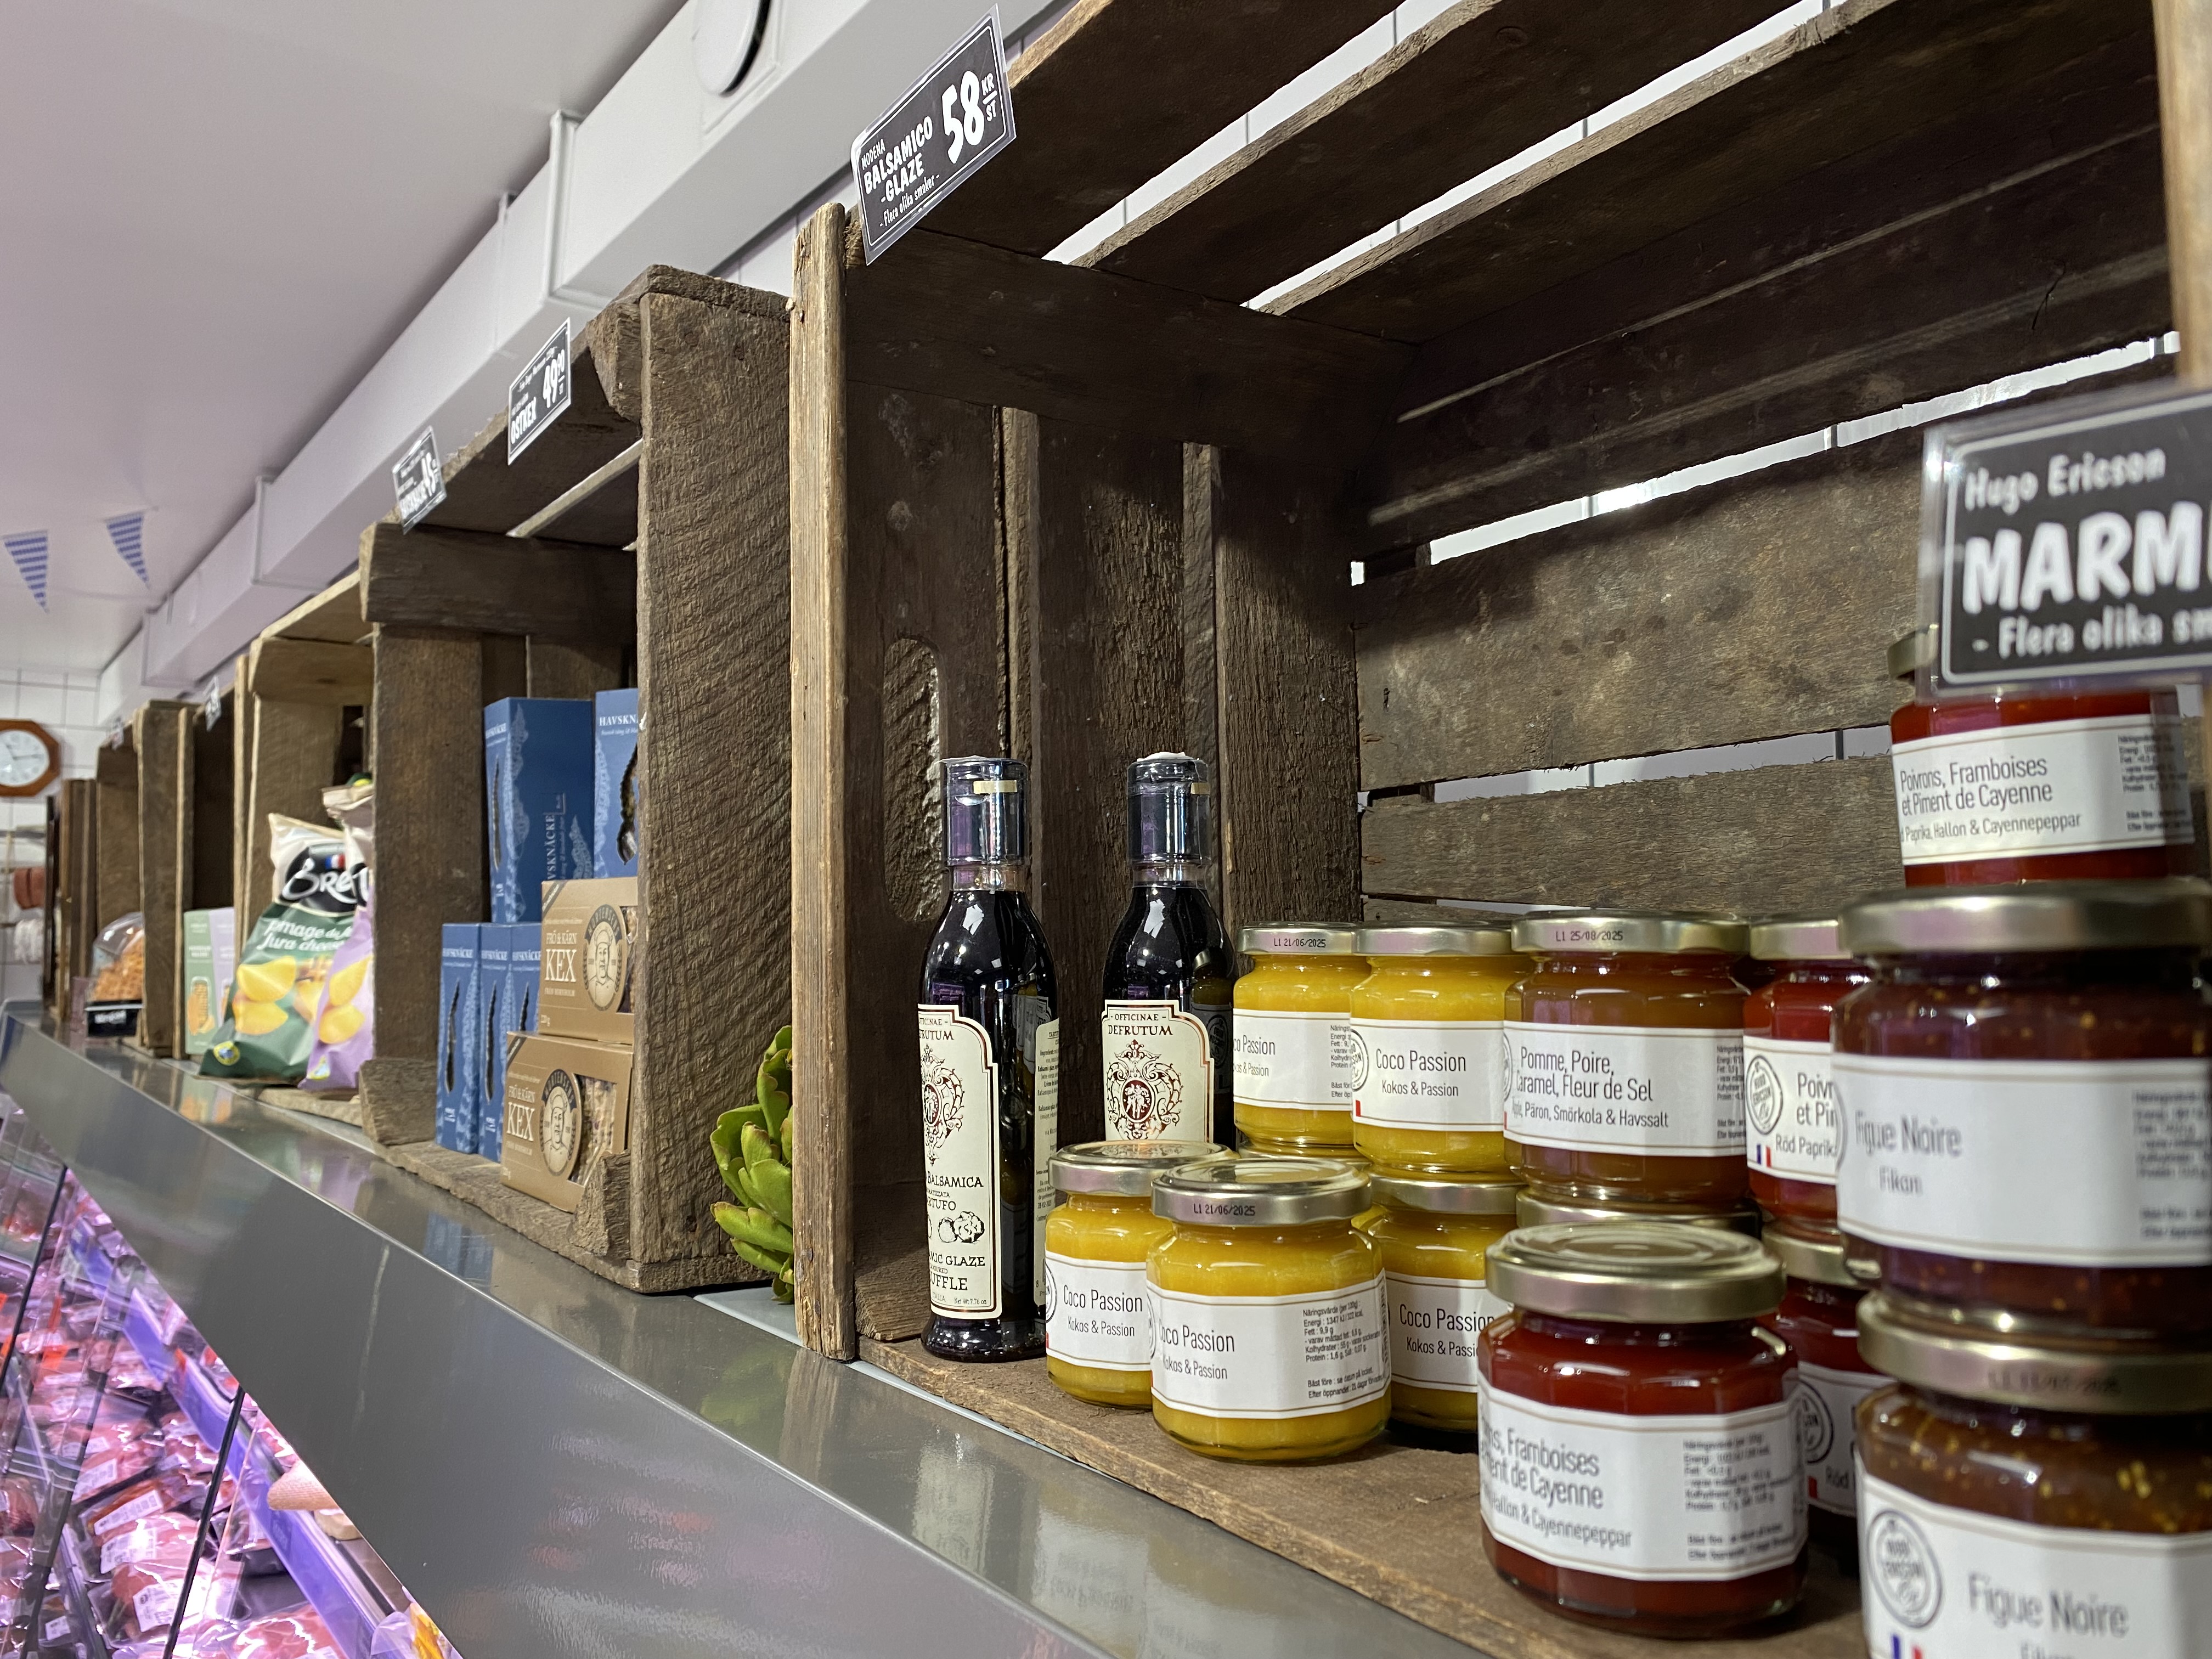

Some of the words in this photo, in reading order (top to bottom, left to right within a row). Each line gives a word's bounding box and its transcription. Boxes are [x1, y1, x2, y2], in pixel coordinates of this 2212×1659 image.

[981, 72, 995, 96] KR
[941, 71, 984, 164] 58
[986, 99, 996, 122] ST
[861, 139, 885, 170] MODENA
[864, 116, 933, 194] BALSAMICO
[883, 208, 899, 227] Flera
[899, 194, 913, 215] olika
[914, 179, 935, 202] smaker
[543, 359, 558, 409] 49
[511, 397, 537, 444] OSTKEX
[1965, 466, 2039, 516] Hugo
[2047, 447, 2166, 496] Ericson
[1962, 500, 2212, 614] MARM
[1998, 613, 2074, 659] Flera
[2082, 603, 2163, 650] olika
[1900, 769, 1946, 792] Poivrons,
[1950, 755, 2048, 785] Framboises
[1901, 795, 1912, 816] et
[1912, 791, 1953, 815] Piment
[1955, 787, 1975, 810] de
[1978, 781, 2053, 812] Cayenne
[1933, 820, 1966, 839] Hallon
[1970, 818, 1980, 835] &
[1982, 813, 2081, 836] Cayennepeppar
[1283, 937, 1326, 949] 21/06/2025
[1570, 930, 1623, 941] 25/08/2025
[545, 949, 577, 982] KEX
[1108, 1024, 1173, 1036] DEFRUTUM
[1243, 1034, 1276, 1055] Passion
[1248, 1062, 1269, 1076] Passion
[1376, 1048, 1404, 1070] Coco
[1410, 1050, 1466, 1072] Passion
[1521, 1046, 1567, 1073] Pomme,
[1572, 1050, 1614, 1075] Poire,
[1382, 1079, 1408, 1096] Kokos
[1410, 1081, 1419, 1096] &
[1421, 1082, 1459, 1097] Passion
[1563, 1074, 1598, 1098] Fleur
[1604, 1077, 1622, 1098] de
[1627, 1079, 1653, 1101] Sel
[506, 1102, 535, 1142] KEX
[1525, 1101, 1552, 1121] Päron,
[1554, 1104, 1602, 1125] Smörkola
[1606, 1111, 1616, 1125] &
[1619, 1110, 1669, 1128] Havssalt
[1797, 1103, 1811, 1125] et
[1776, 1133, 1796, 1153] Röd
[1855, 1109, 1897, 1156] Figue
[1901, 1115, 1963, 1158] Noire
[928, 1170, 984, 1188] BALSAMICA
[1205, 1203, 1256, 1217] 21/06/2025
[946, 1255, 985, 1267] GLAZE
[1063, 1284, 1086, 1308] Coco
[1091, 1289, 1143, 1312] Passion
[1068, 1316, 1089, 1333] Kokos
[1091, 1321, 1098, 1334] &
[1101, 1321, 1135, 1336] Passion
[1400, 1304, 1431, 1328] Coco
[1159, 1318, 1179, 1346] Coco
[1182, 1324, 1235, 1352] Passion
[1407, 1336, 1434, 1354] Kokos
[1437, 1341, 1446, 1355] &
[1163, 1354, 1182, 1373] Kokos
[1184, 1359, 1192, 1375] &
[1193, 1361, 1228, 1380] Passion
[1508, 1428, 1599, 1477] Framboises
[1511, 1460, 1527, 1491] de
[1530, 1466, 1604, 1509] Cayenne
[1532, 1506, 1632, 1550] Cayennepeppar
[1968, 1572, 2044, 1629] Figue
[2049, 1589, 2129, 1639] Noire
